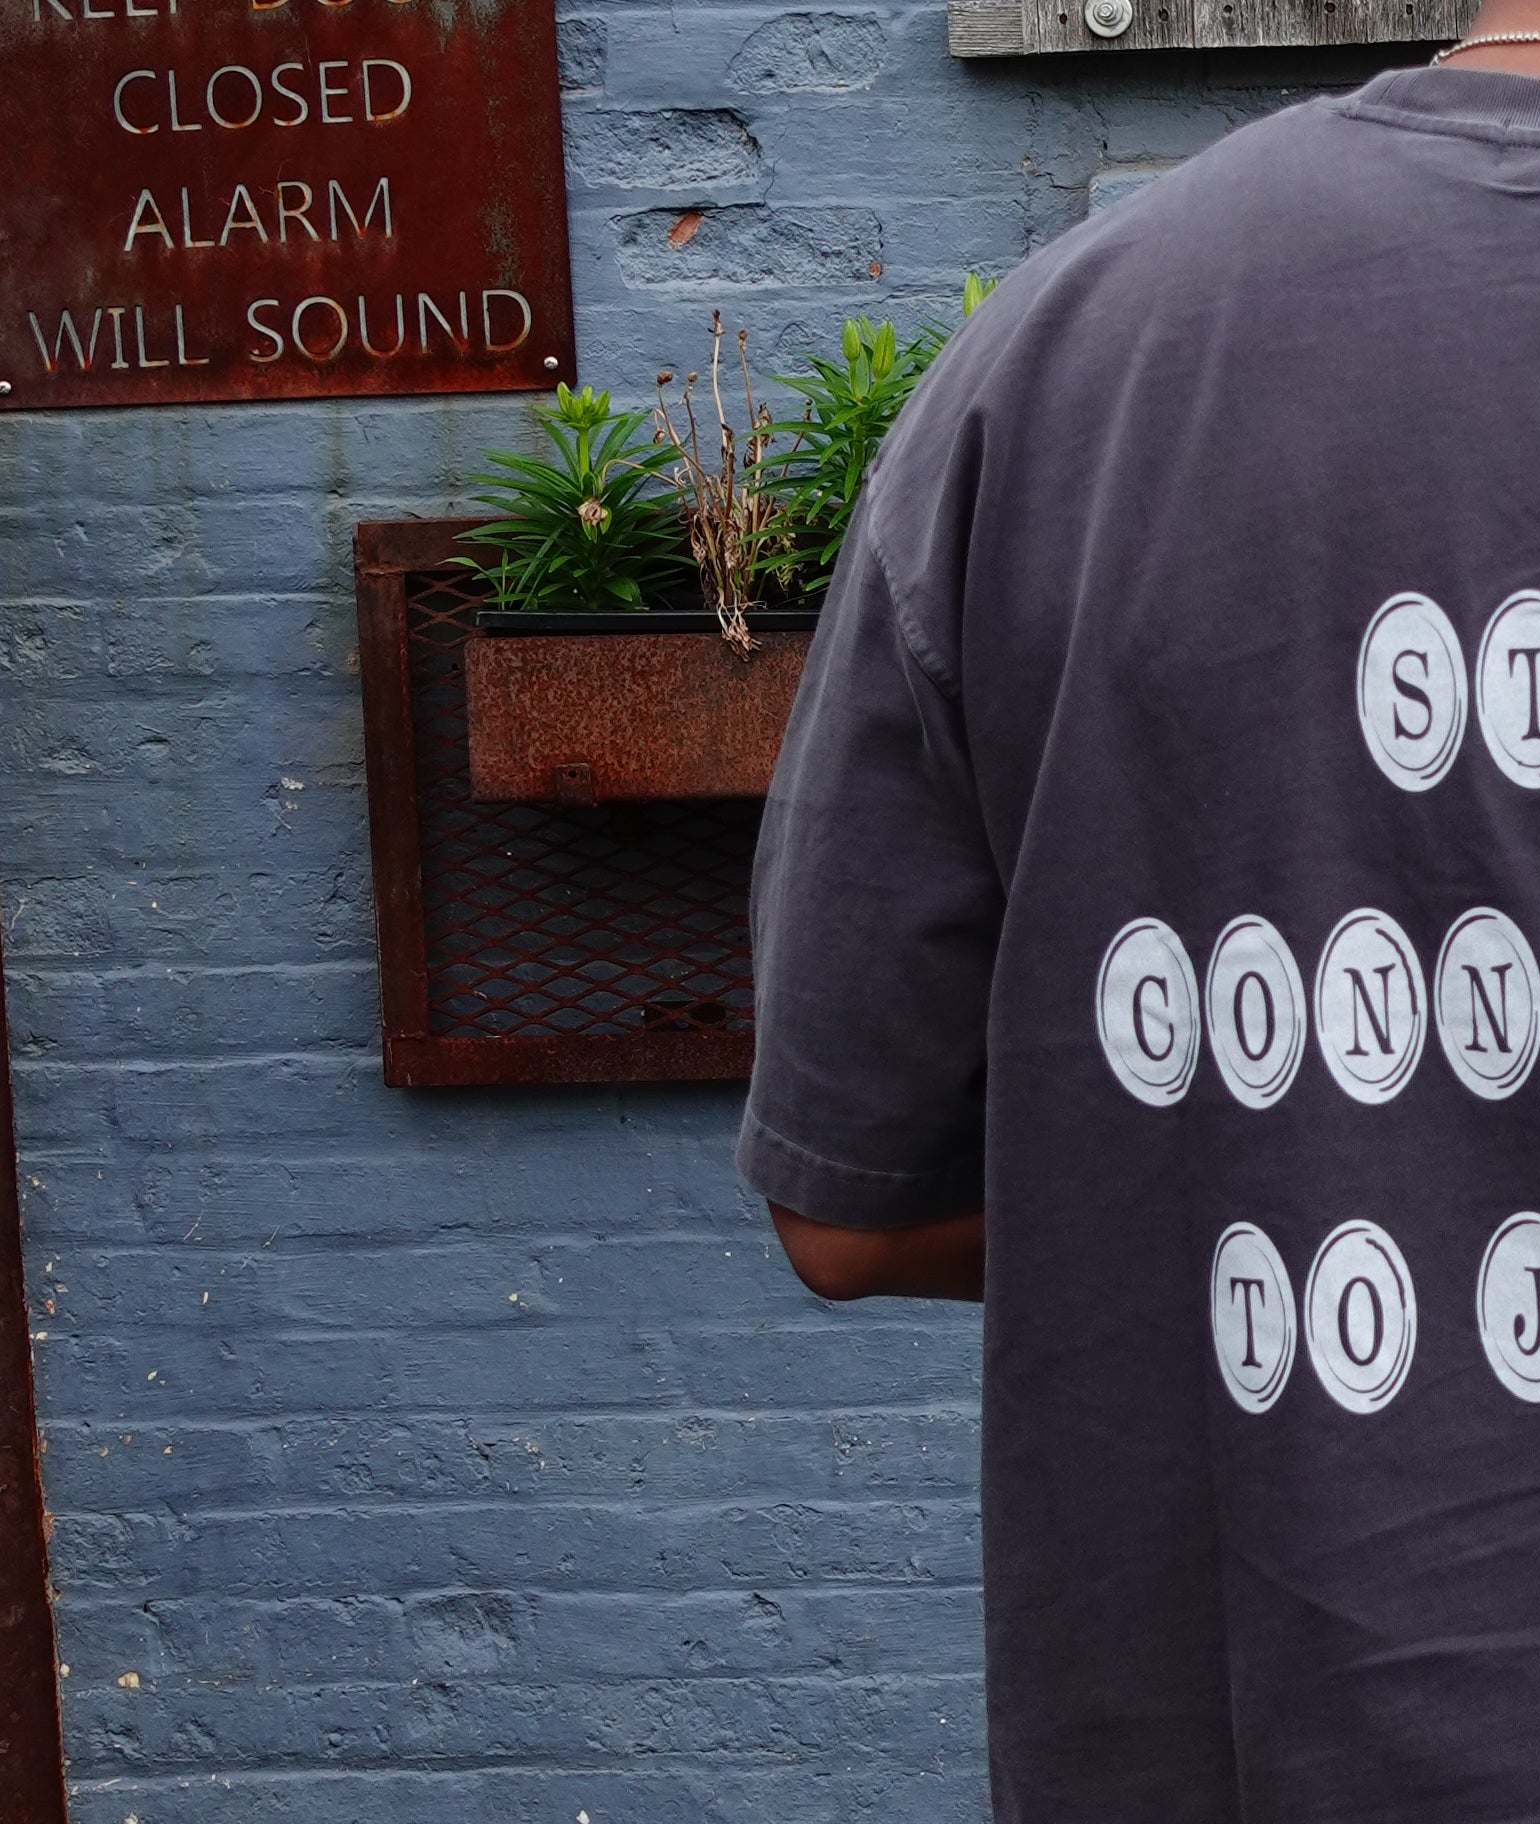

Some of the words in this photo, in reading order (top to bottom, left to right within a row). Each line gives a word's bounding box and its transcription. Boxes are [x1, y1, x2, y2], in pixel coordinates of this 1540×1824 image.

[113, 58, 413, 134] CLOSED
[123, 176, 393, 252] ALARM
[28, 303, 210, 371] WILL
[246, 288, 533, 363] SOUND
